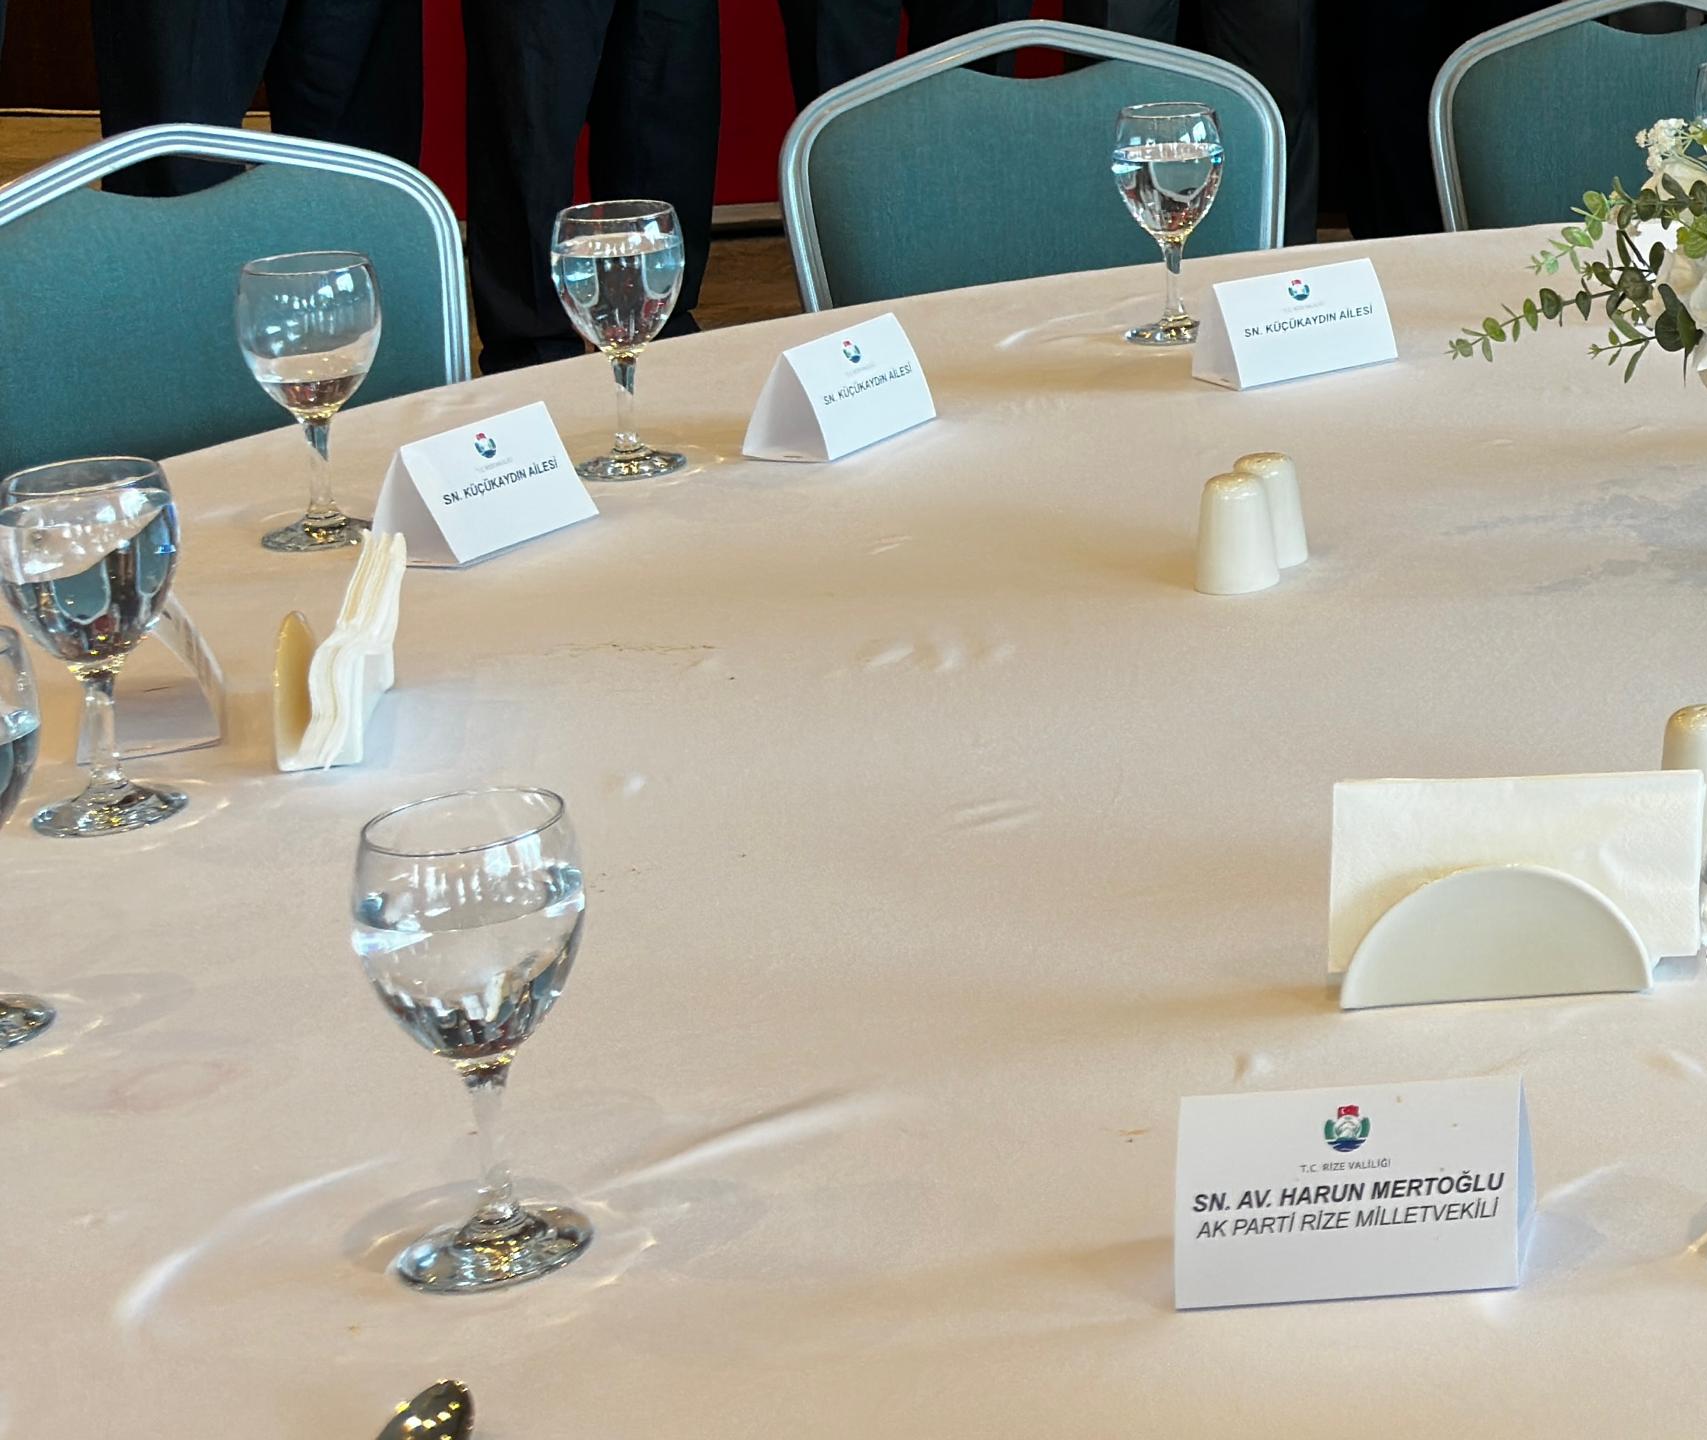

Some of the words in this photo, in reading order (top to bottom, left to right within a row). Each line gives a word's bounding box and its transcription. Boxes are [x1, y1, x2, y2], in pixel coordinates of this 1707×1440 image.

[1244, 327, 1263, 338] SN.
[1265, 312, 1337, 334] KÜÇÜKAYDIN
[1339, 304, 1373, 320] AİLESİ
[823, 394, 837, 406] SN.
[888, 361, 913, 381] AİLESİ
[443, 492, 462, 505] SN.
[464, 468, 526, 499] KÜÇÜKAYDIN
[528, 456, 558, 475] AİLESİ
[1193, 1192, 1231, 1213] SN.
[1237, 1189, 1272, 1210] AV.
[1280, 1182, 1366, 1206] HARUN
[1371, 1170, 1505, 1200] MERTOĞLU
[1196, 1218, 1227, 1239] AK
[1232, 1212, 1296, 1237] PARTİ
[1300, 1209, 1352, 1232] RİZE
[1355, 1196, 1500, 1228] MİLLETVEKİLİ
